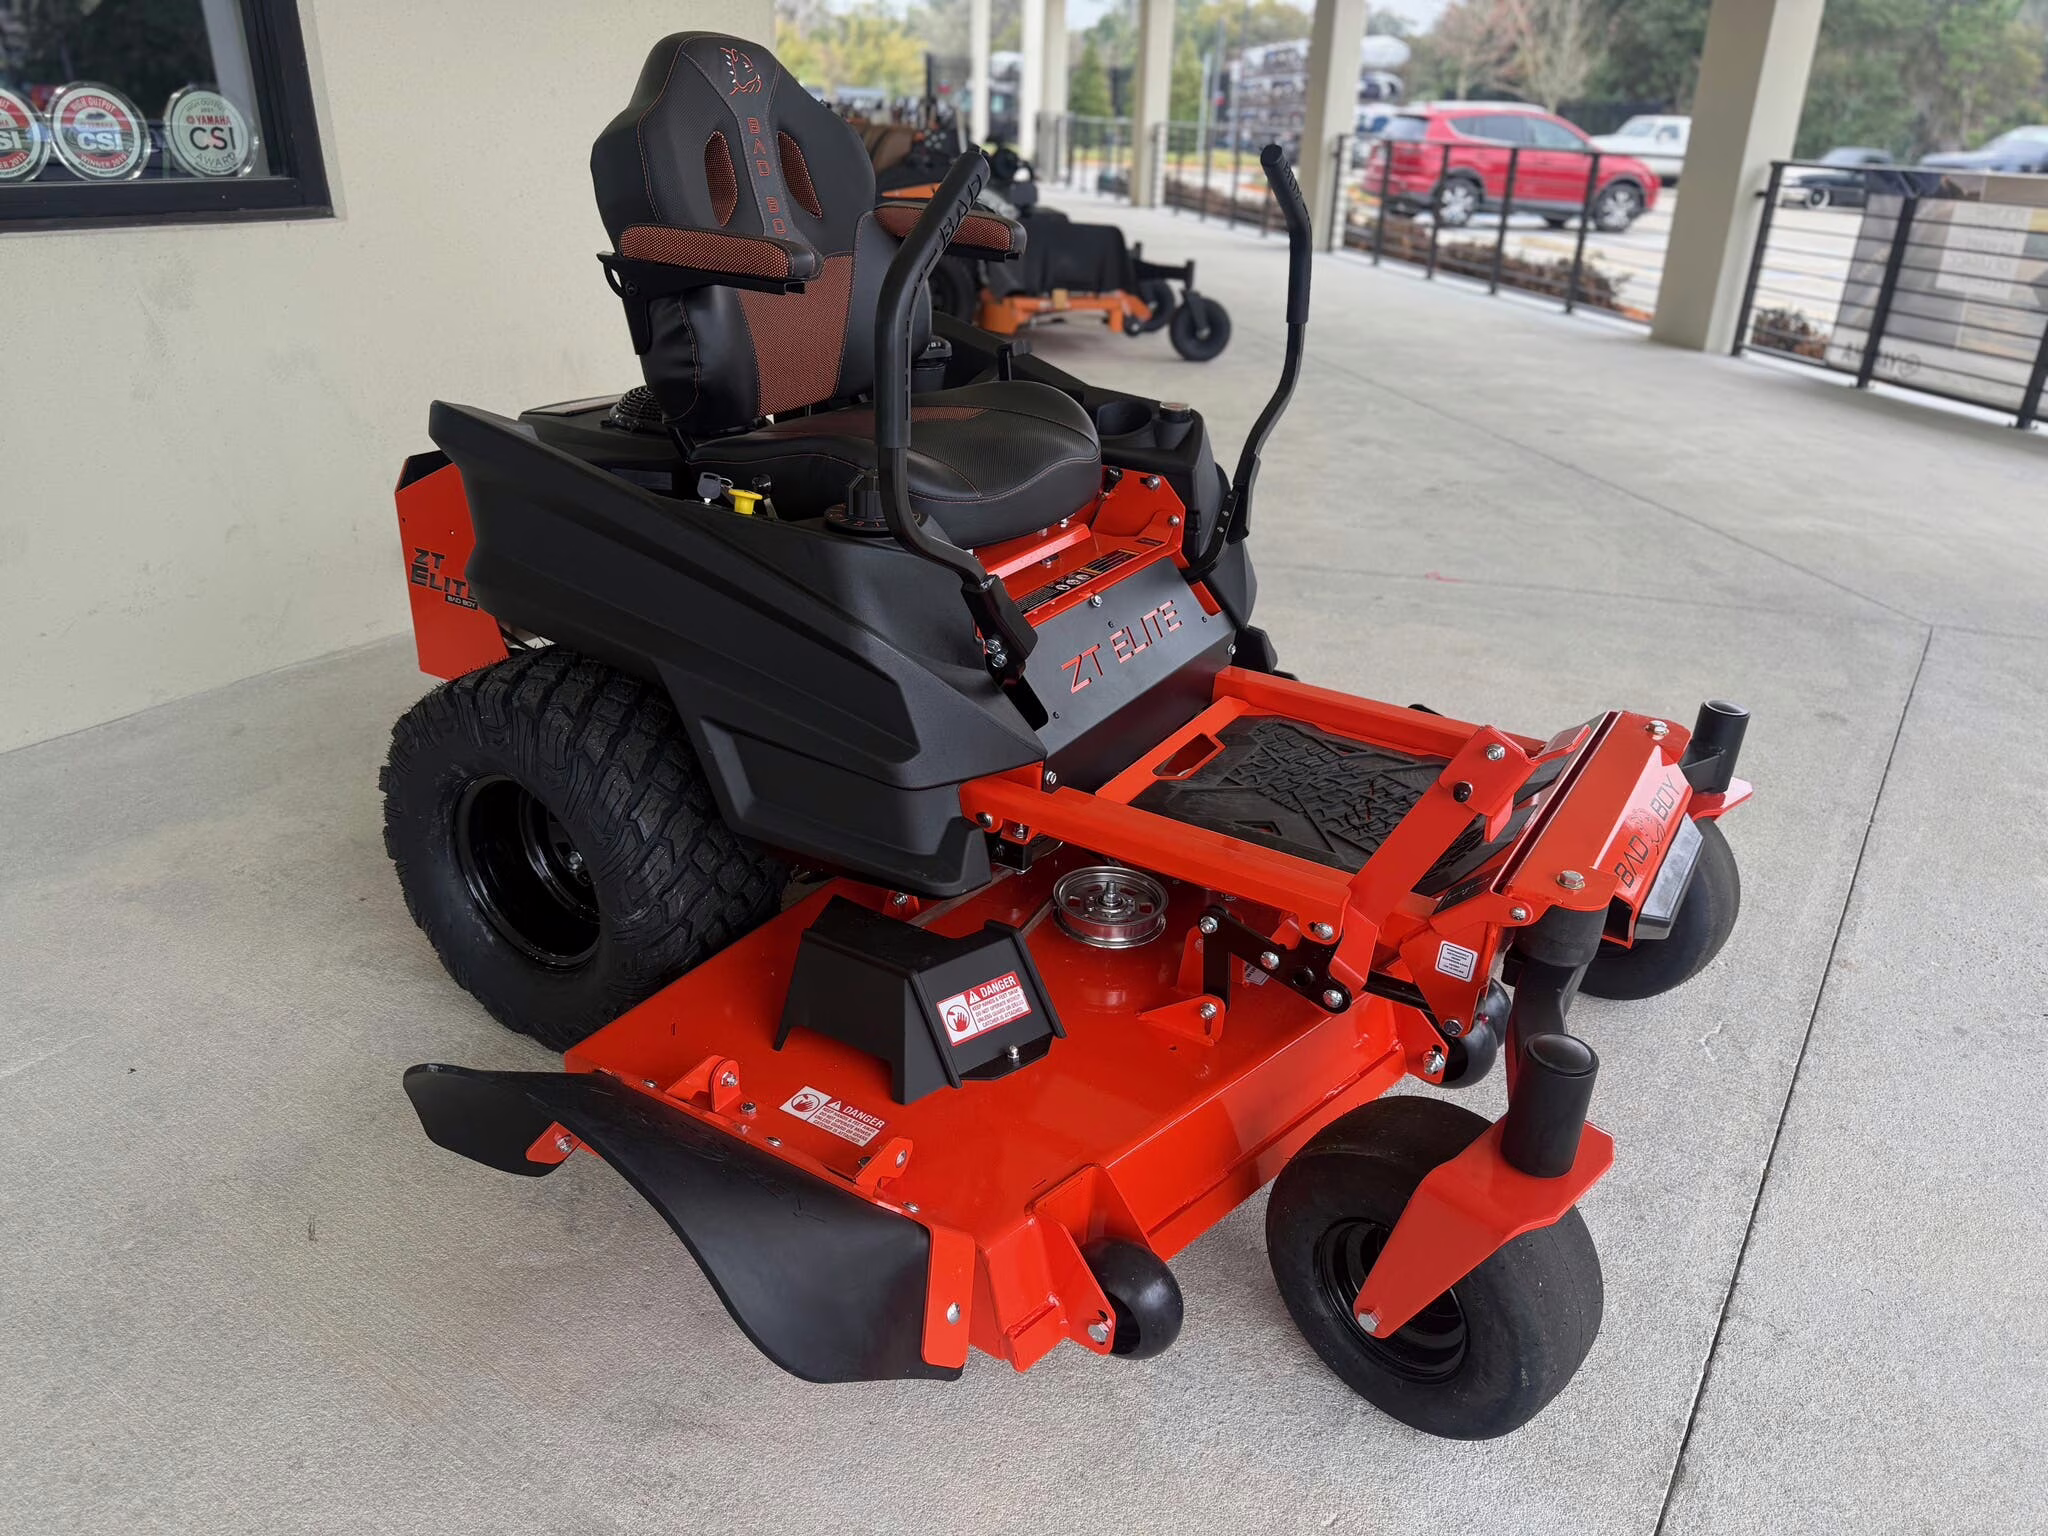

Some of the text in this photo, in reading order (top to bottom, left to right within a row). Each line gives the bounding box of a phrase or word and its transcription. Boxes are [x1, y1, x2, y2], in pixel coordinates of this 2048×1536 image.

[88, 97, 116, 113] OUTPUT
[196, 115, 232, 126] YAMAHA
[77, 132, 124, 150] CSI
[189, 126, 236, 151] CSI
[80, 154, 110, 169] WINNER
[195, 151, 236, 167] AWARD
[414, 547, 446, 570] ZT
[411, 563, 478, 601] ELIT
[1061, 600, 1183, 694] ZT ELITE
[1614, 774, 1680, 888] BAD BOY
[980, 976, 1017, 998] DANGER
[843, 1106, 886, 1128] DANGER
